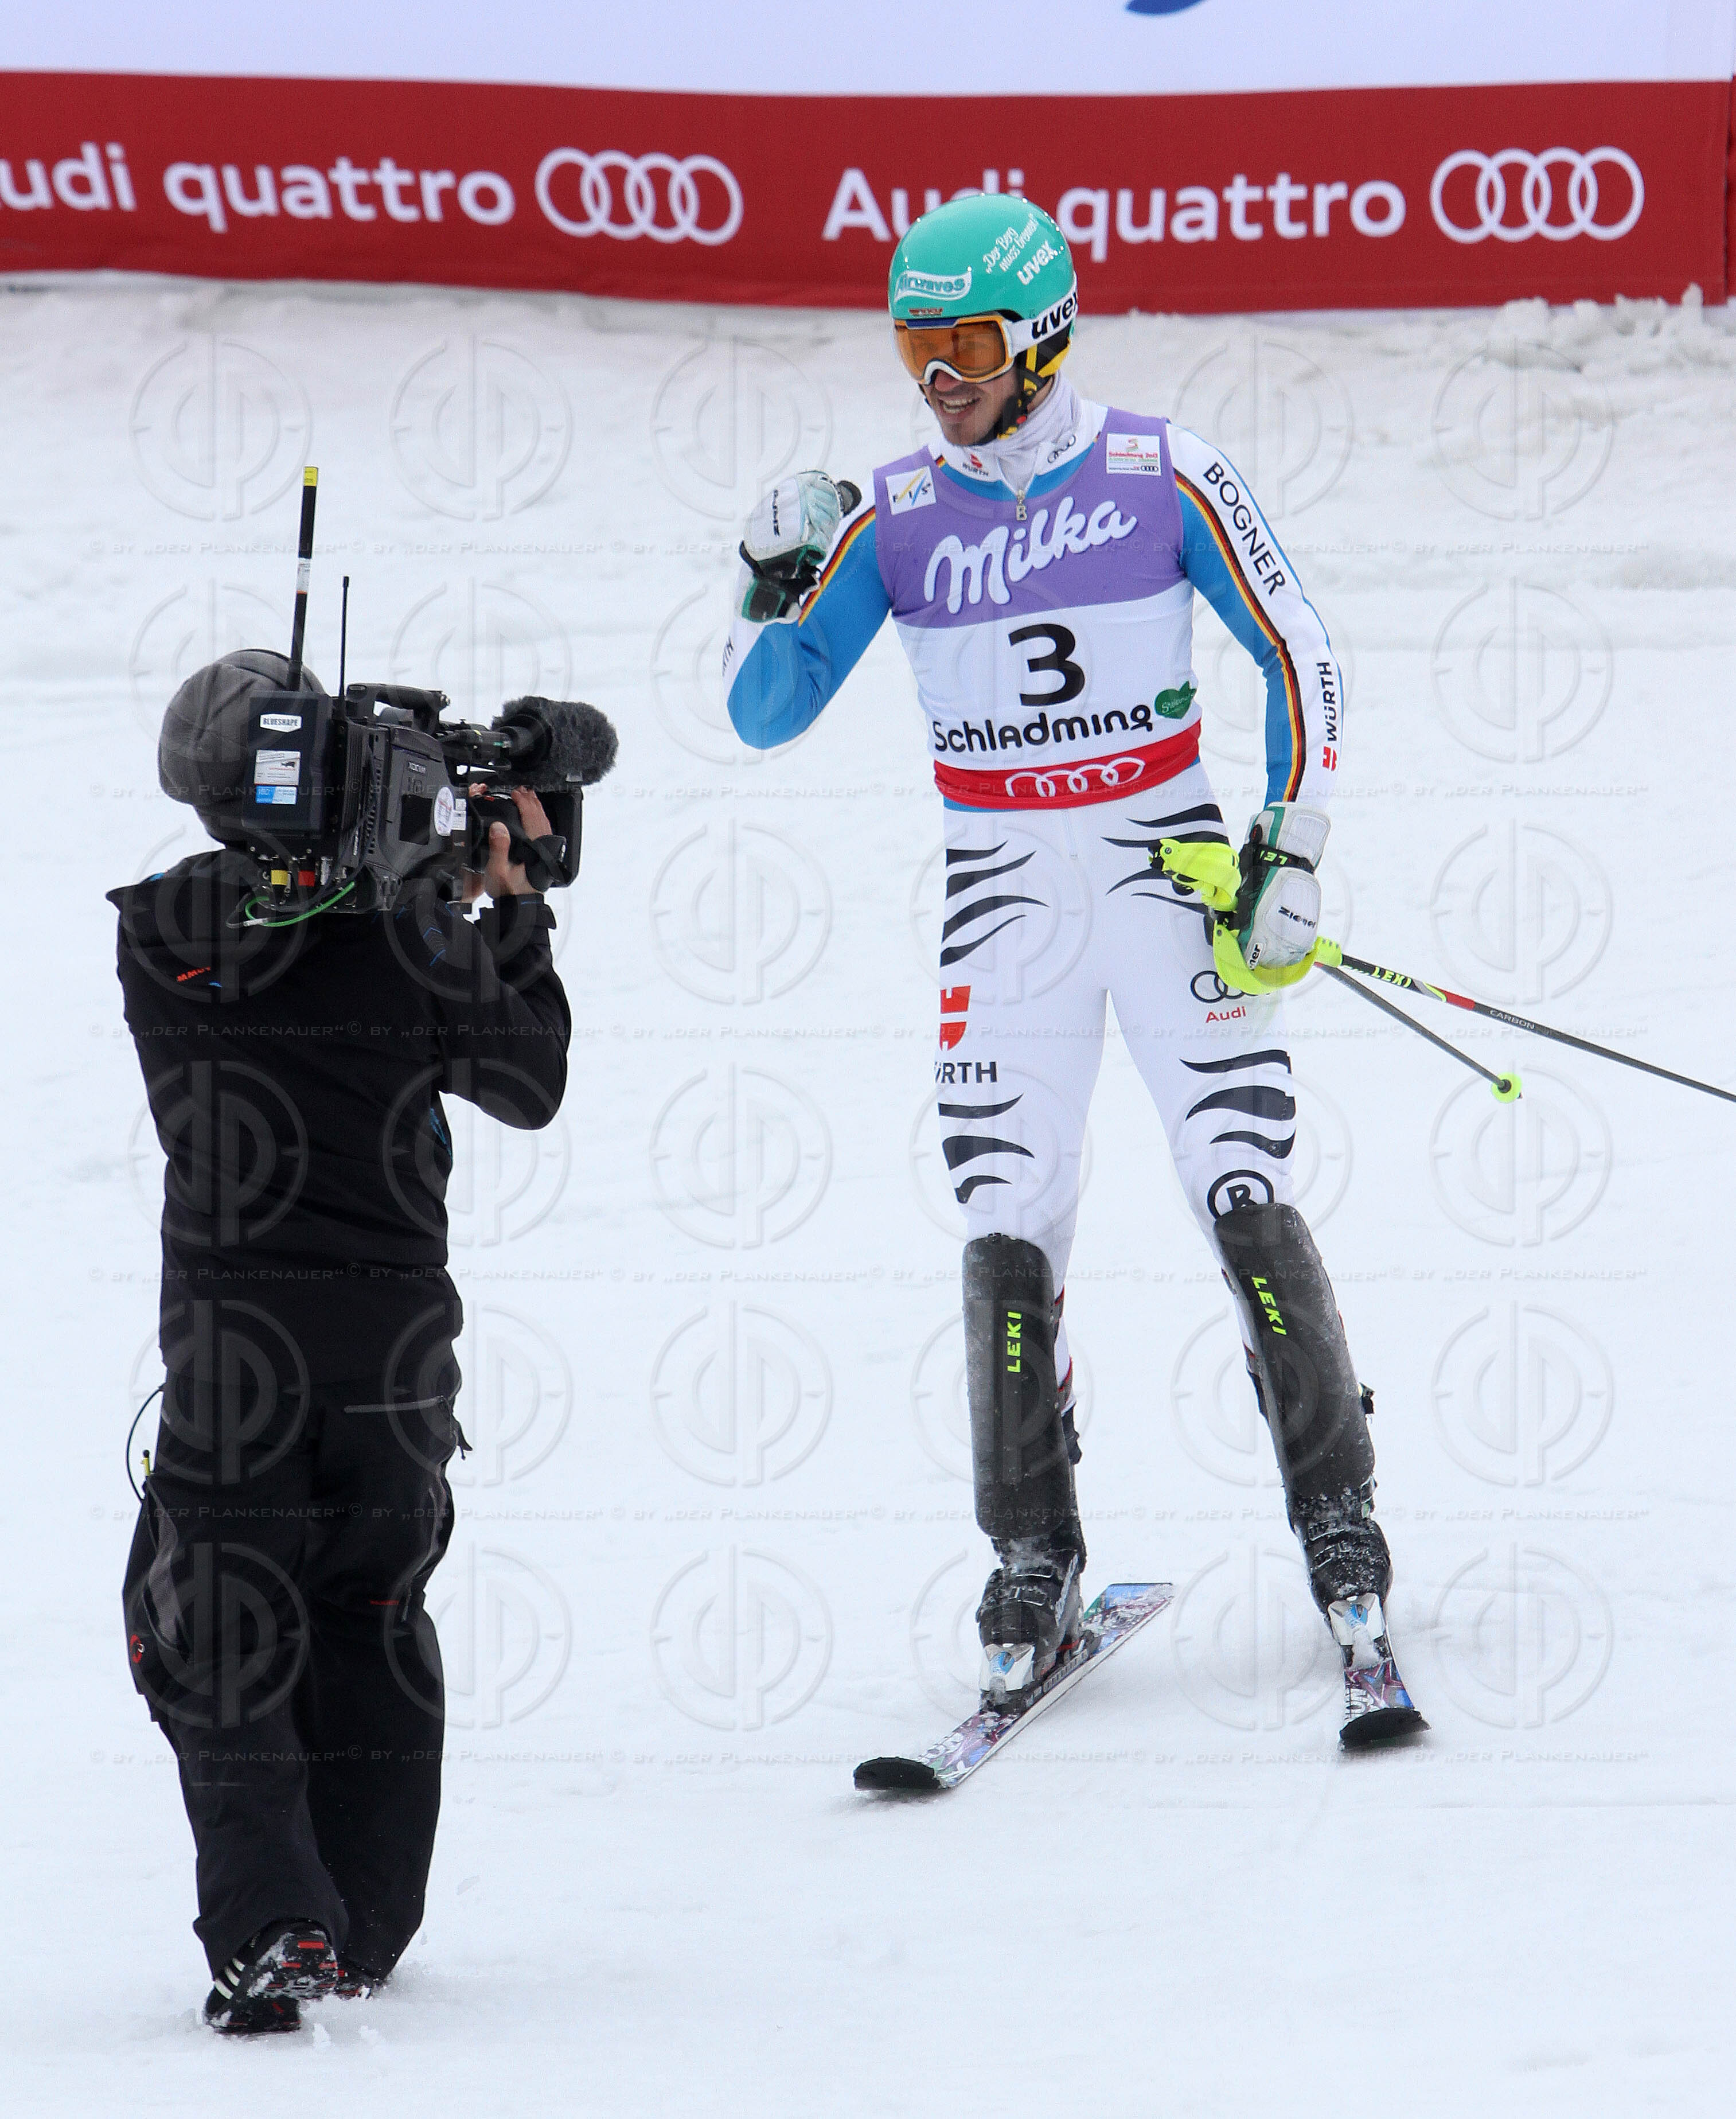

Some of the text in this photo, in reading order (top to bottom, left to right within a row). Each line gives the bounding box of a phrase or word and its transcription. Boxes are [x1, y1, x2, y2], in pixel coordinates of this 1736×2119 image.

[0, 140, 515, 233] udi quattro
[1056, 173, 1407, 262] quattro
[1017, 239, 1056, 286] uvex
[924, 495, 1138, 614] Milka
[1203, 462, 1286, 596] BOGNER
[1008, 623, 1086, 706] 3
[933, 704, 1153, 753] Schladming
[1316, 662, 1337, 742] WÜRTH
[1249, 944, 1260, 969] ner
[1372, 967, 1412, 988] LEKI
[1206, 1006, 1246, 1023] Audi
[1489, 1010, 1535, 1030] CARBON
[1251, 1277, 1286, 1335] LEKI
[1007, 1311, 1021, 1373] LEKI
